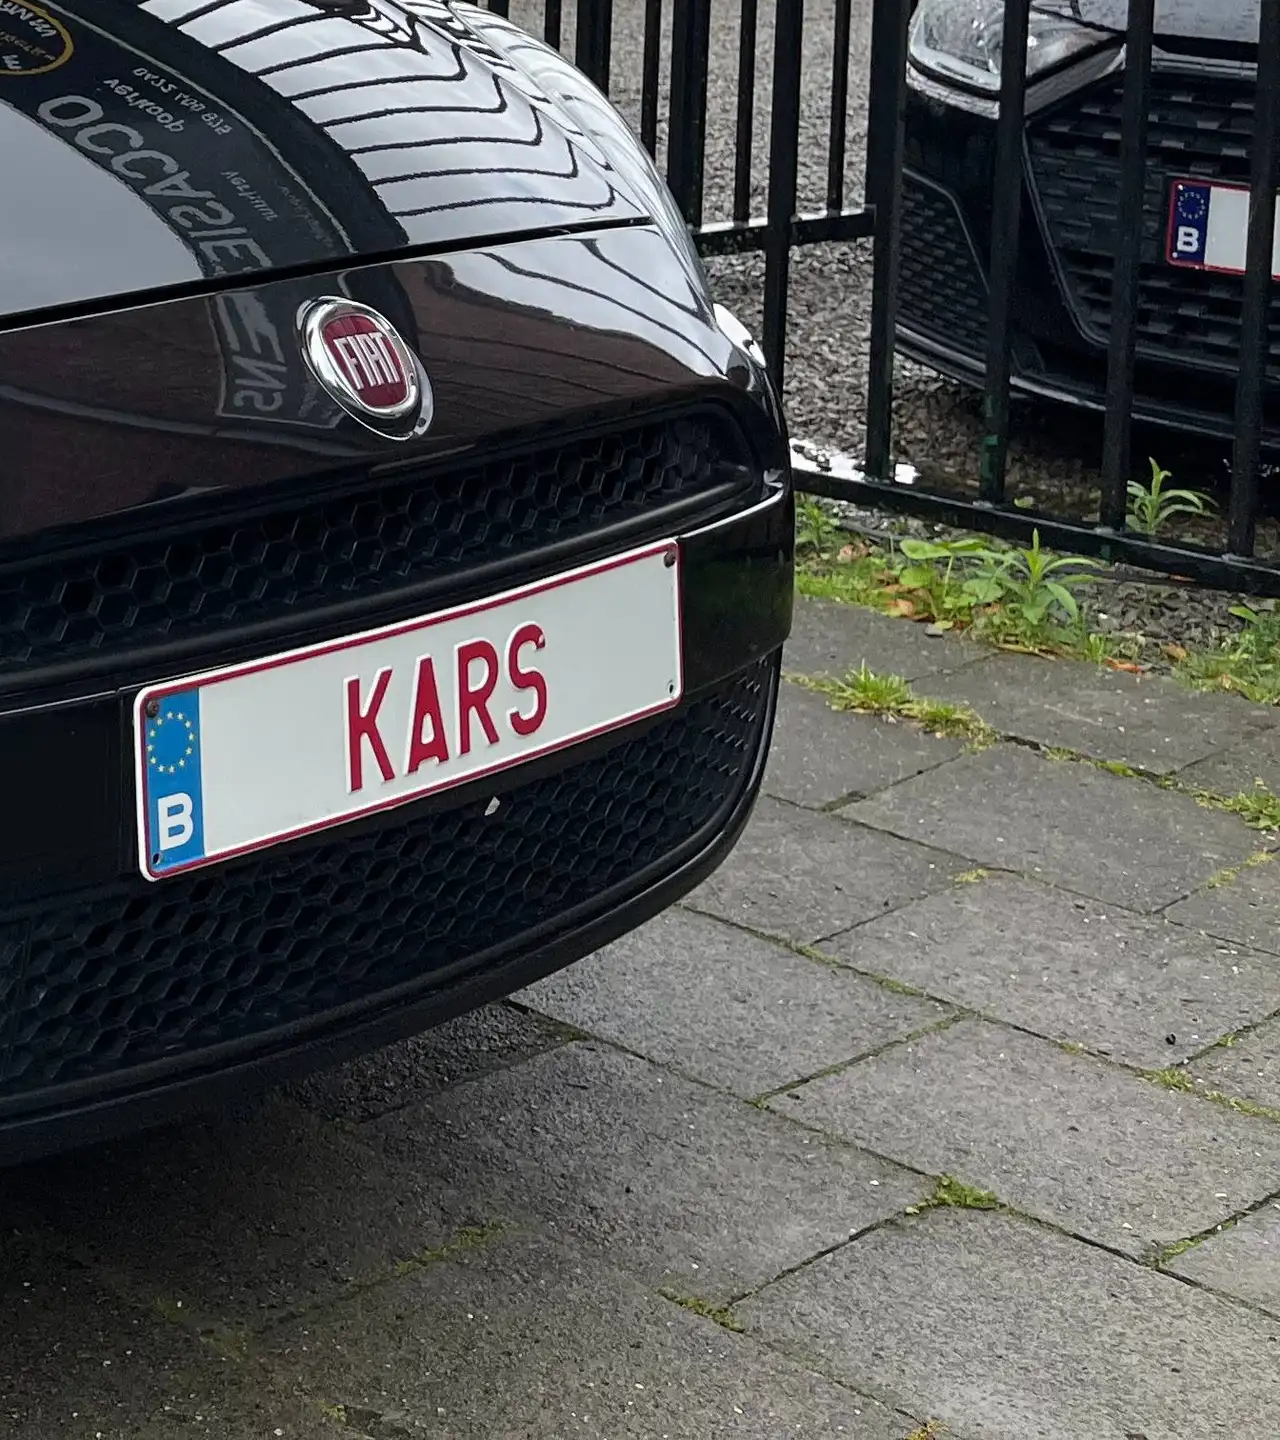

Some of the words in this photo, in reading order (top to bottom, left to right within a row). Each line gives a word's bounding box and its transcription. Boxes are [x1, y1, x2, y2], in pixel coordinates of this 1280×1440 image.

[1175, 226, 1200, 255] B
[332, 331, 401, 390] FIAT
[156, 792, 194, 850] B
[343, 620, 548, 795] KARS
